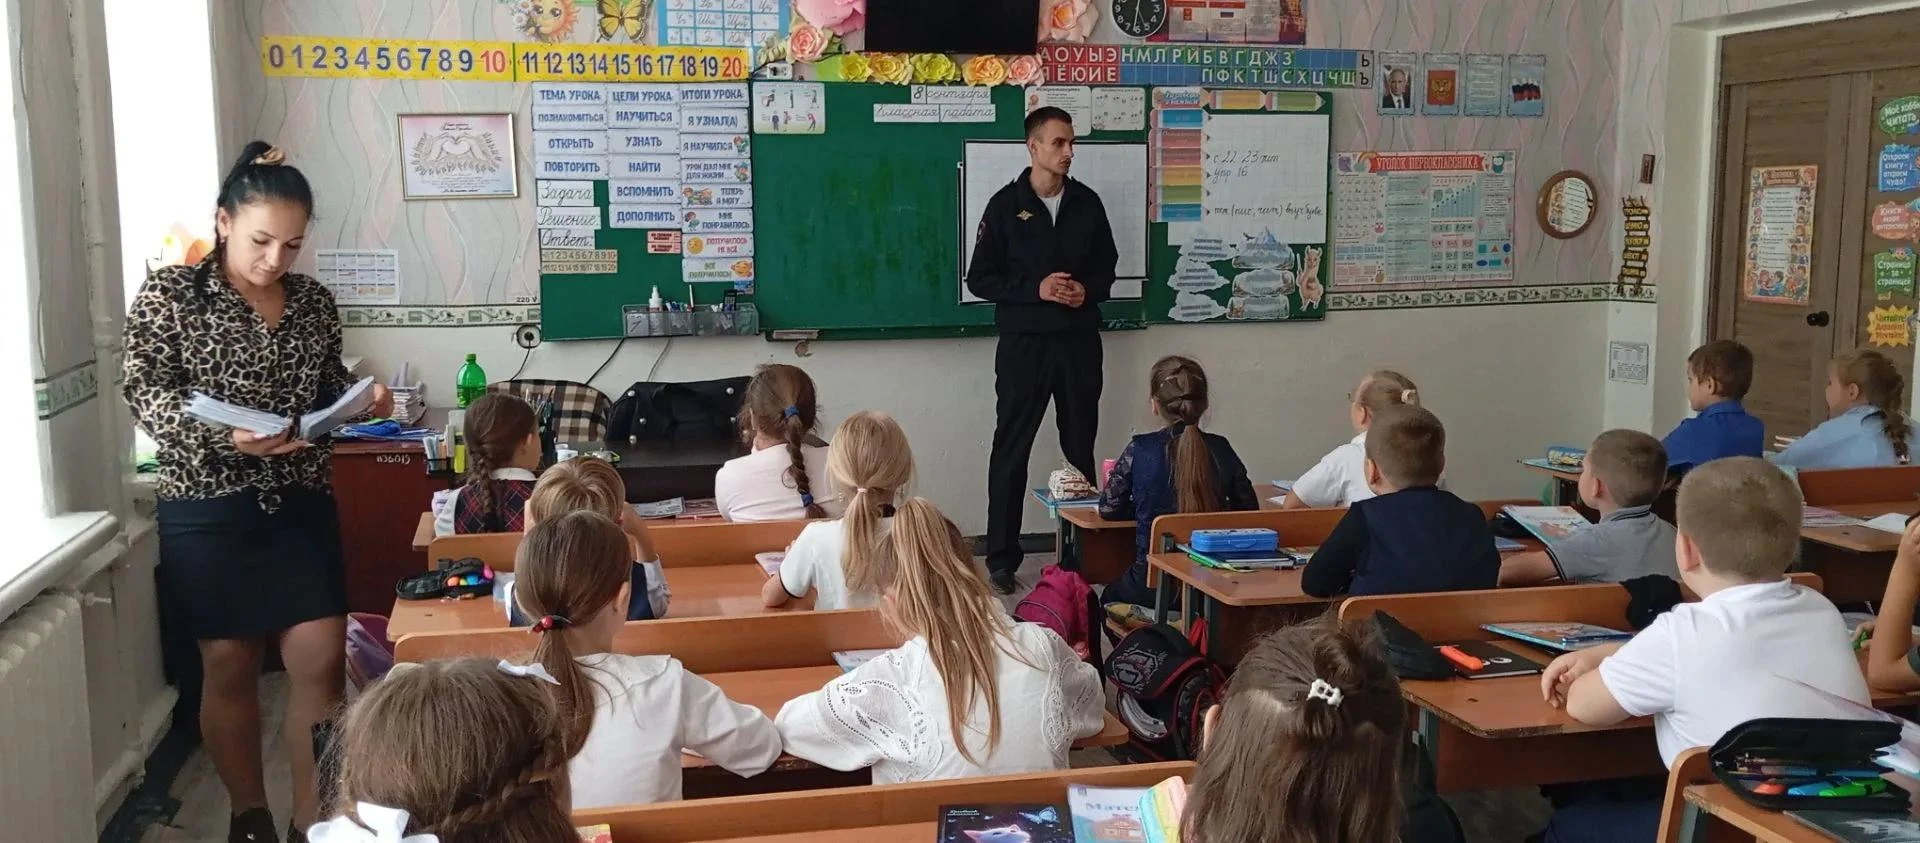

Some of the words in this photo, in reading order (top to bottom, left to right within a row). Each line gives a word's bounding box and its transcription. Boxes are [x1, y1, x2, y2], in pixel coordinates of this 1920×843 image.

[269, 45, 284, 68] 0
[292, 45, 302, 68] 1
[312, 46, 327, 68] 2
[334, 46, 348, 69] 3
[354, 47, 370, 70] 4
[376, 48, 390, 70] 5
[397, 48, 411, 70] 6
[418, 48, 431, 71] 7
[438, 49, 453, 72] 8
[458, 49, 472, 72] 9
[480, 50, 506, 72] 10
[522, 52, 538, 73] 11
[544, 53, 563, 73] 12
[567, 53, 585, 74] 13
[589, 54, 608, 75] 14
[613, 54, 630, 75] 15
[635, 54, 651, 75] 16
[657, 55, 674, 75] 17
[679, 55, 696, 76] 18
[701, 56, 718, 77] 19
[722, 56, 742, 77] 20
[540, 90, 566, 100] ТЕМА
[569, 90, 600, 101] УРОКА
[613, 91, 639, 102] ЦЕЛИ
[642, 91, 672, 101] УРОКА
[682, 90, 711, 100] ИТОГИ
[713, 89, 743, 99] УРОКА
[914, 87, 924, 99] 8
[538, 113, 604, 122] ПОЗНАКОМИТЬСЯ
[616, 111, 672, 122] НАУЧИТЬСЯ
[942, 104, 994, 120] работа
[688, 117, 694, 126] Я
[548, 138, 594, 149] ОТКРЫТЬ
[625, 136, 662, 147] УЗНАТЬ
[690, 142, 732, 151] НАУЧИЛСЯ
[1241, 150, 1259, 163] 23
[544, 162, 600, 172] ПОВТОРИТЬ
[629, 160, 661, 173] НАЙТИ
[1376, 157, 1406, 169] УГОЛОК
[1409, 156, 1478, 169] ПЕРВОКЛАССНИКА
[1238, 166, 1248, 176] 16
[542, 180, 592, 206] Задача
[617, 186, 674, 197] ВСПОМНИТЬ
[616, 211, 675, 223] ДОПОЛНИТЬ
[702, 222, 749, 230] ПОНРАВИЛОСЬ
